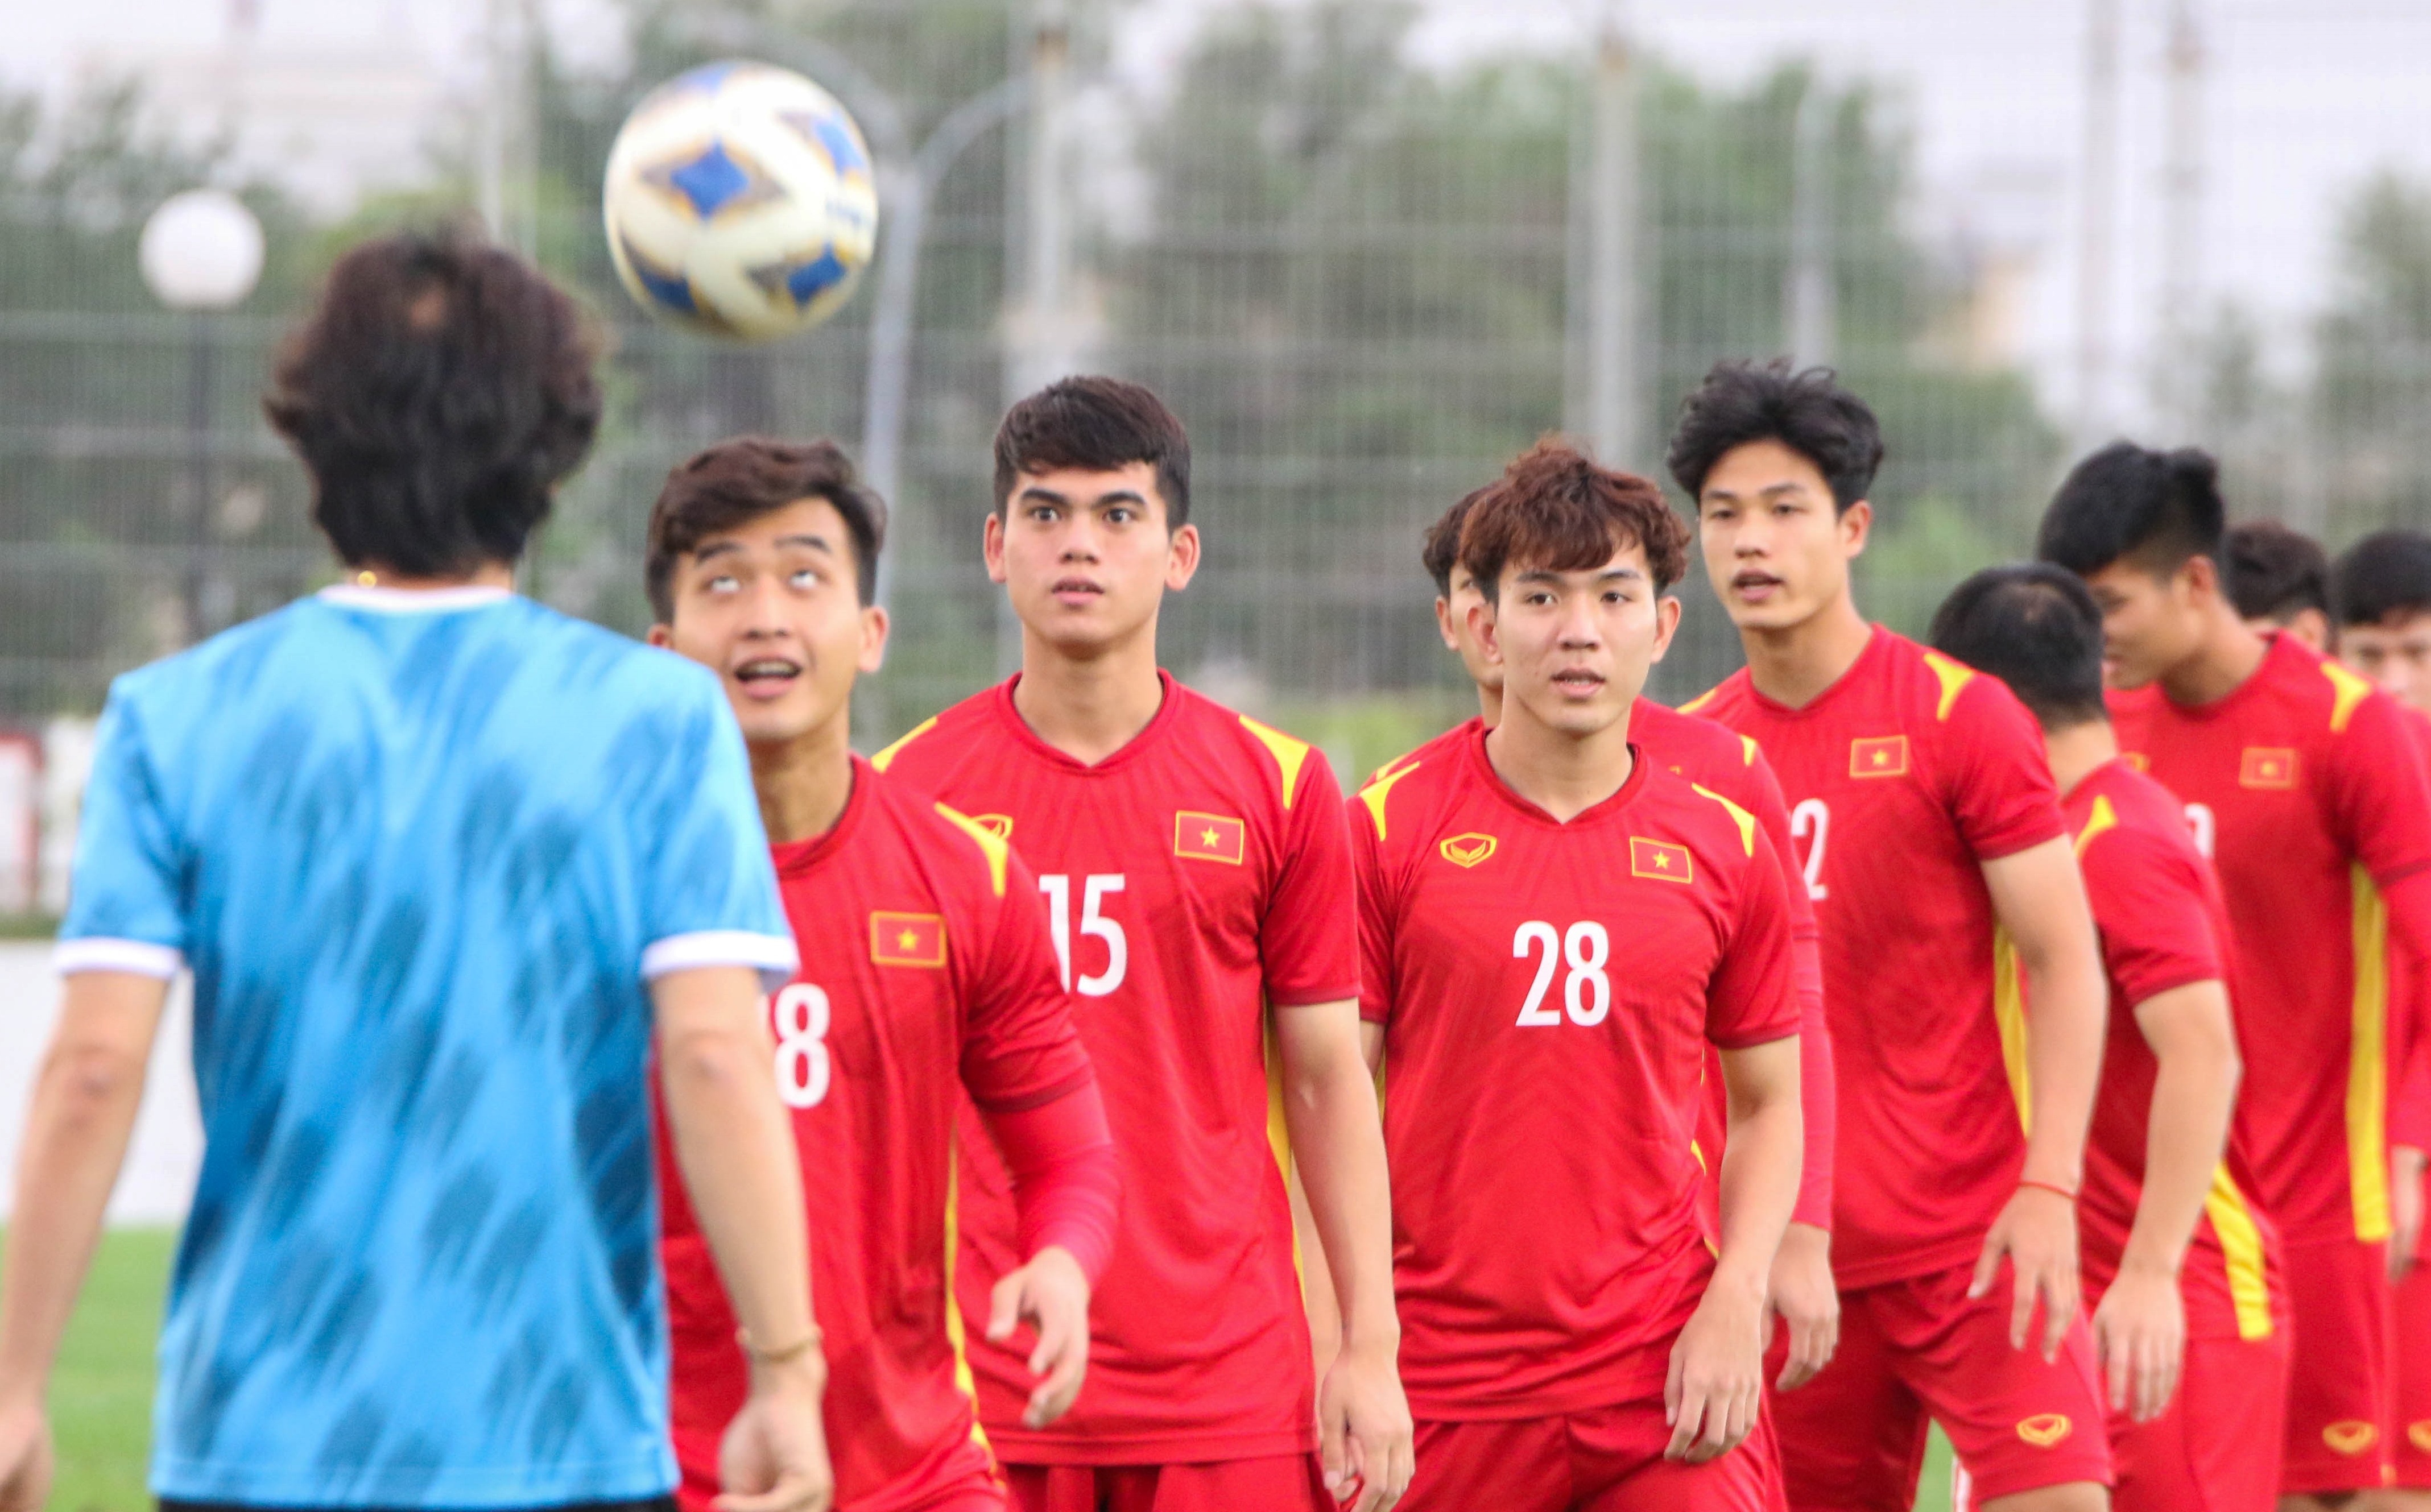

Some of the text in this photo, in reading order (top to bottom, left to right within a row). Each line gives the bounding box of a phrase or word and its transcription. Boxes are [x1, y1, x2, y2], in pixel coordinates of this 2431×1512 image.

[1039, 873, 1127, 996] 15
[1513, 920, 1610, 1026] 28
[761, 983, 830, 1108] 8
